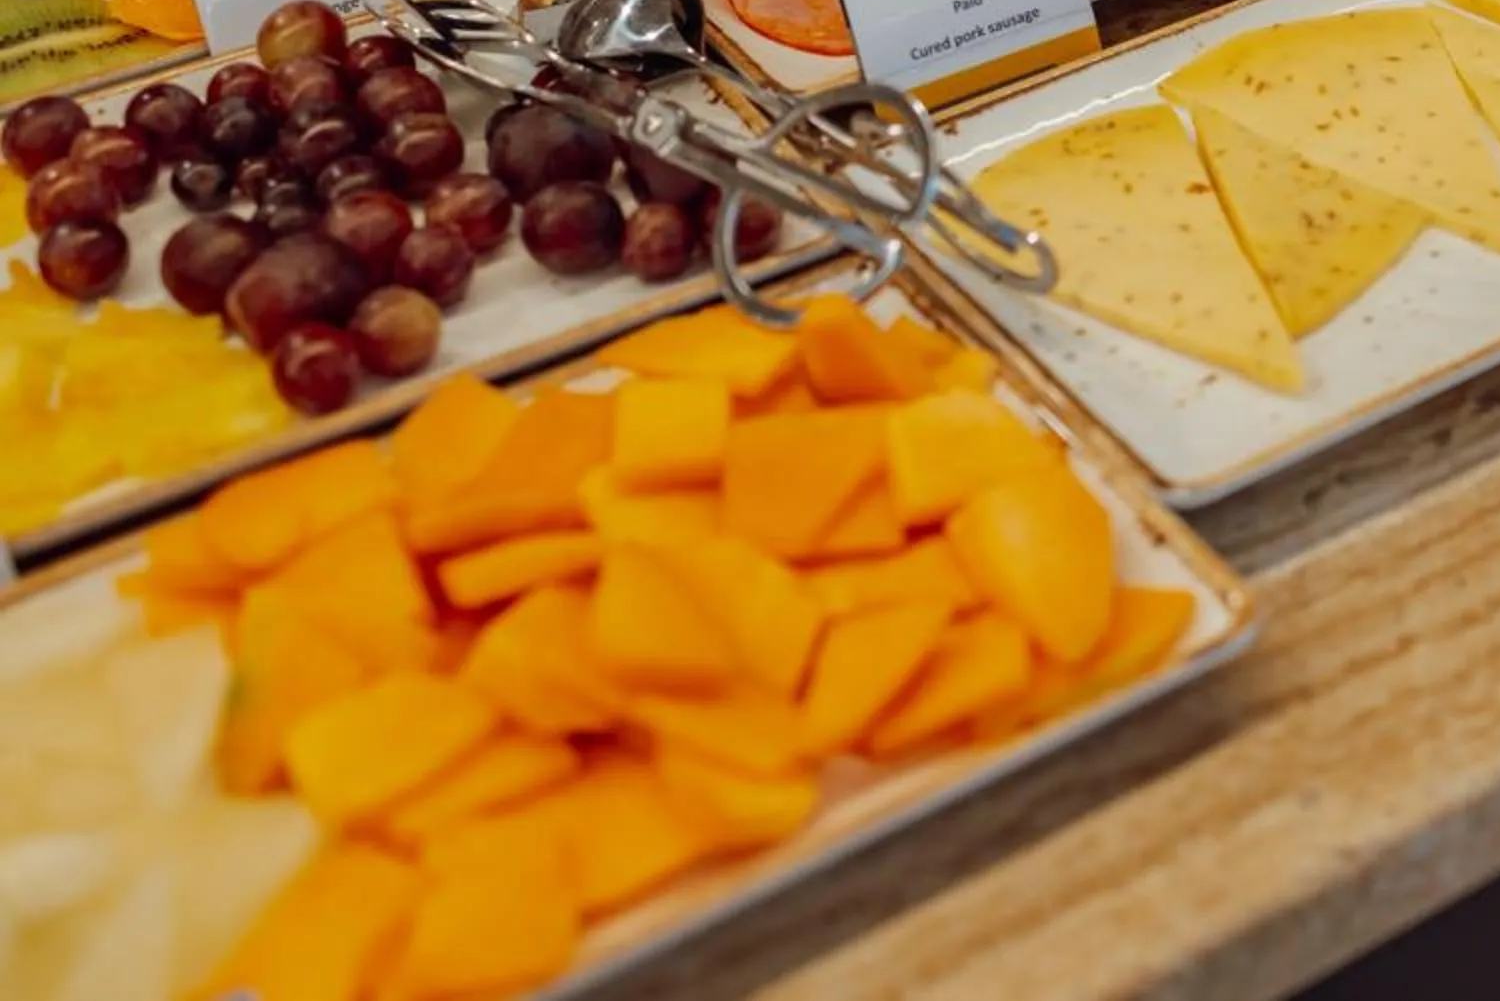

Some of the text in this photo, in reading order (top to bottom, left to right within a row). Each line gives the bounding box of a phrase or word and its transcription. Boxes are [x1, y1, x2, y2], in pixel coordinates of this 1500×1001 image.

[910, 7, 1041, 61] Cured pork sausage
